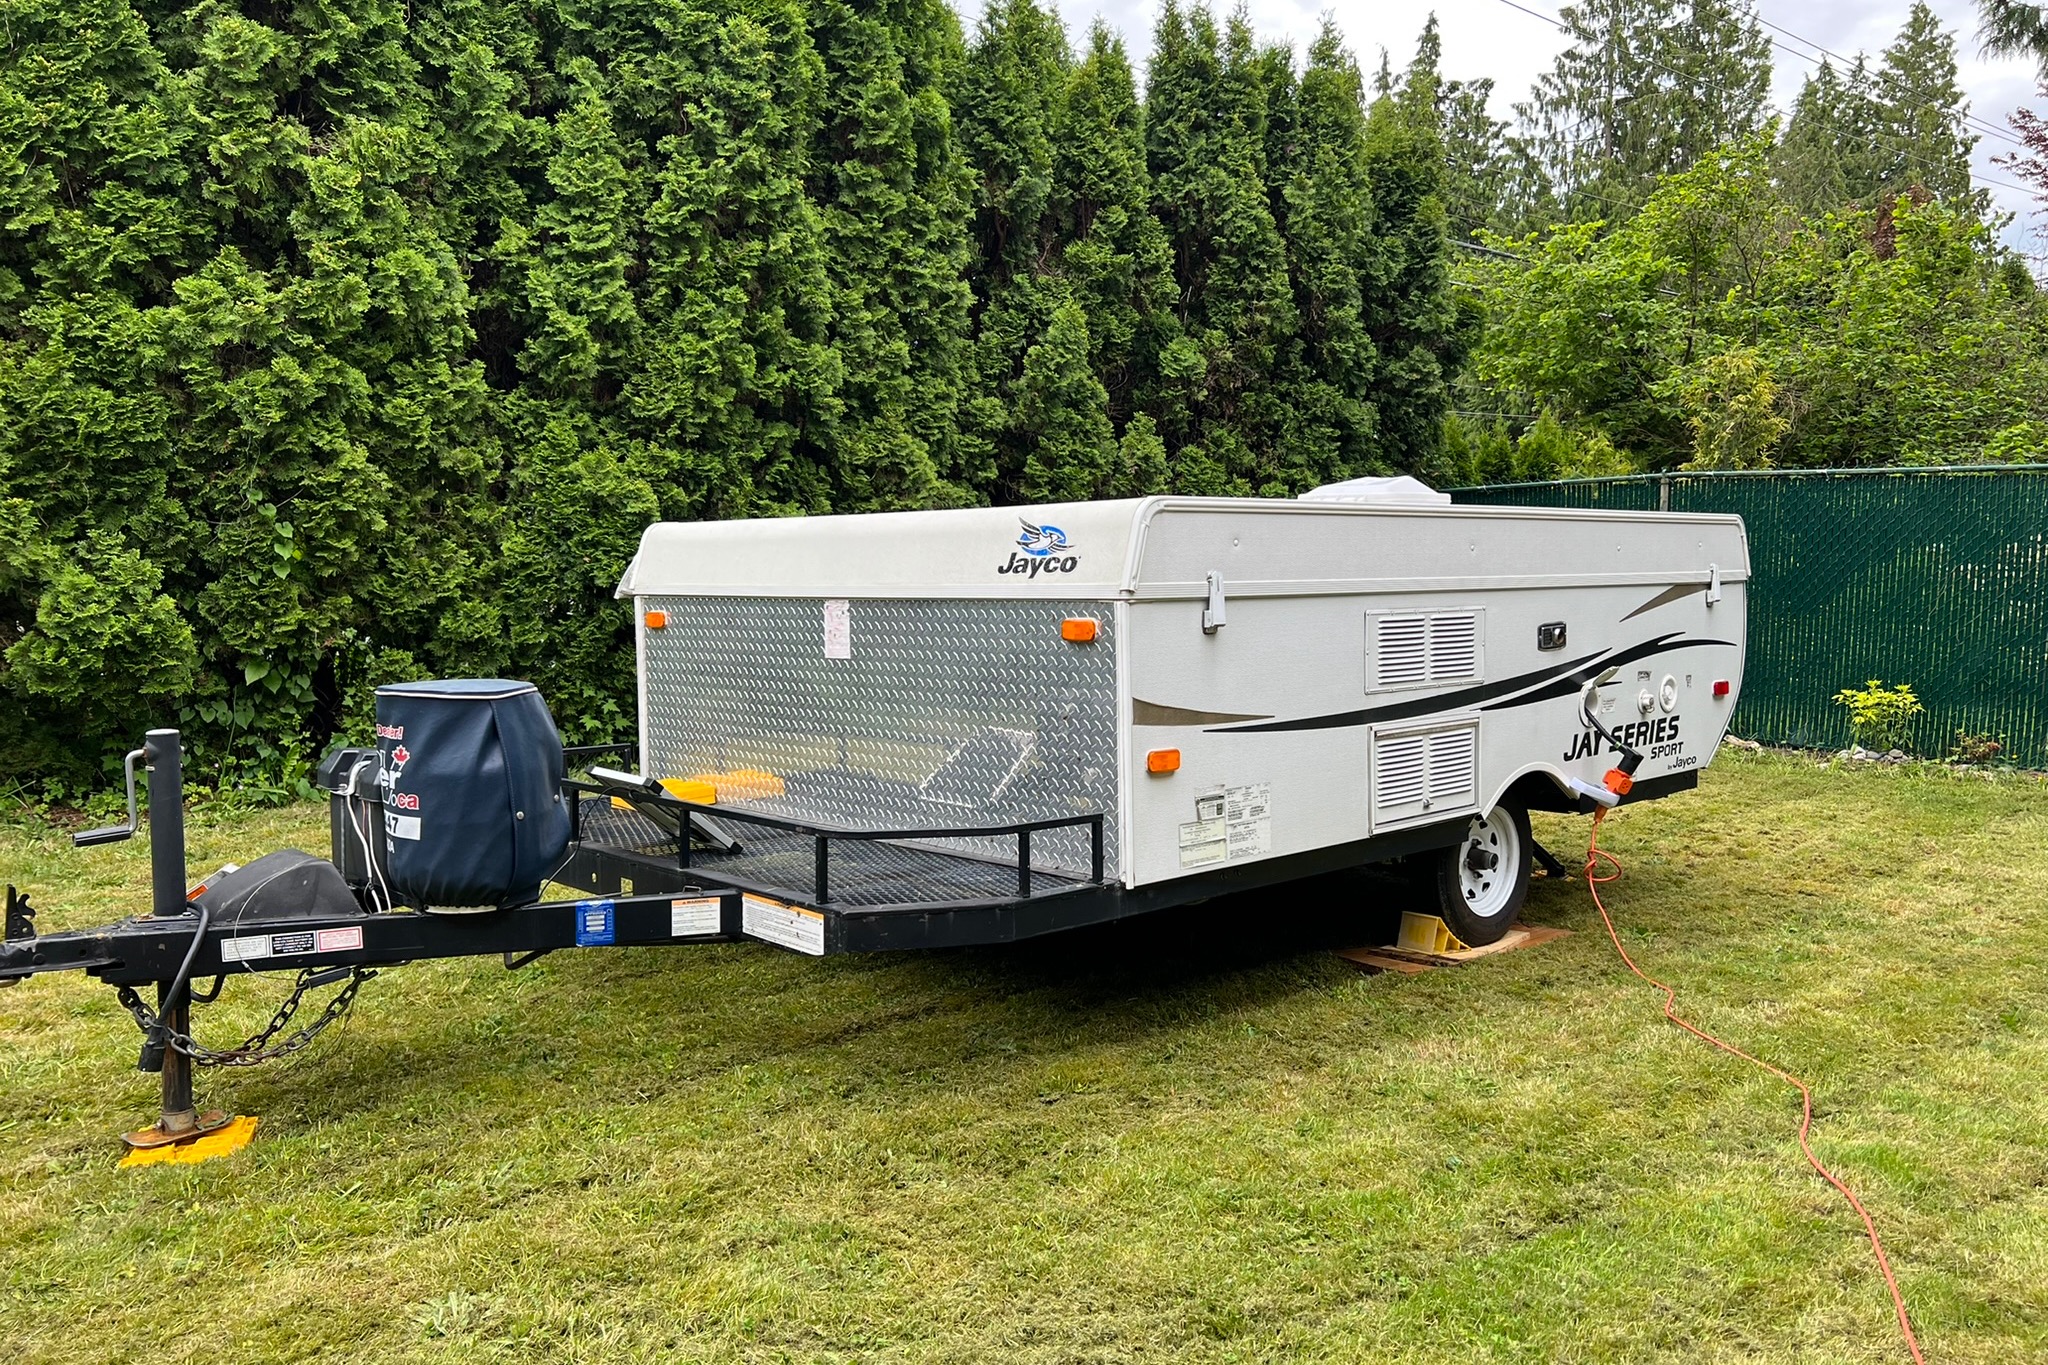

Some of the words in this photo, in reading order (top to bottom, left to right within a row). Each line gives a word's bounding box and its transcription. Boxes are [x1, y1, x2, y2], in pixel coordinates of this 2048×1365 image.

[997, 552, 1079, 579] Jayco
[1563, 728, 1605, 762] JAY
[1608, 715, 1681, 753] SERIES
[1650, 741, 1684, 760] SPORT
[1672, 755, 1697, 769] Jayco
